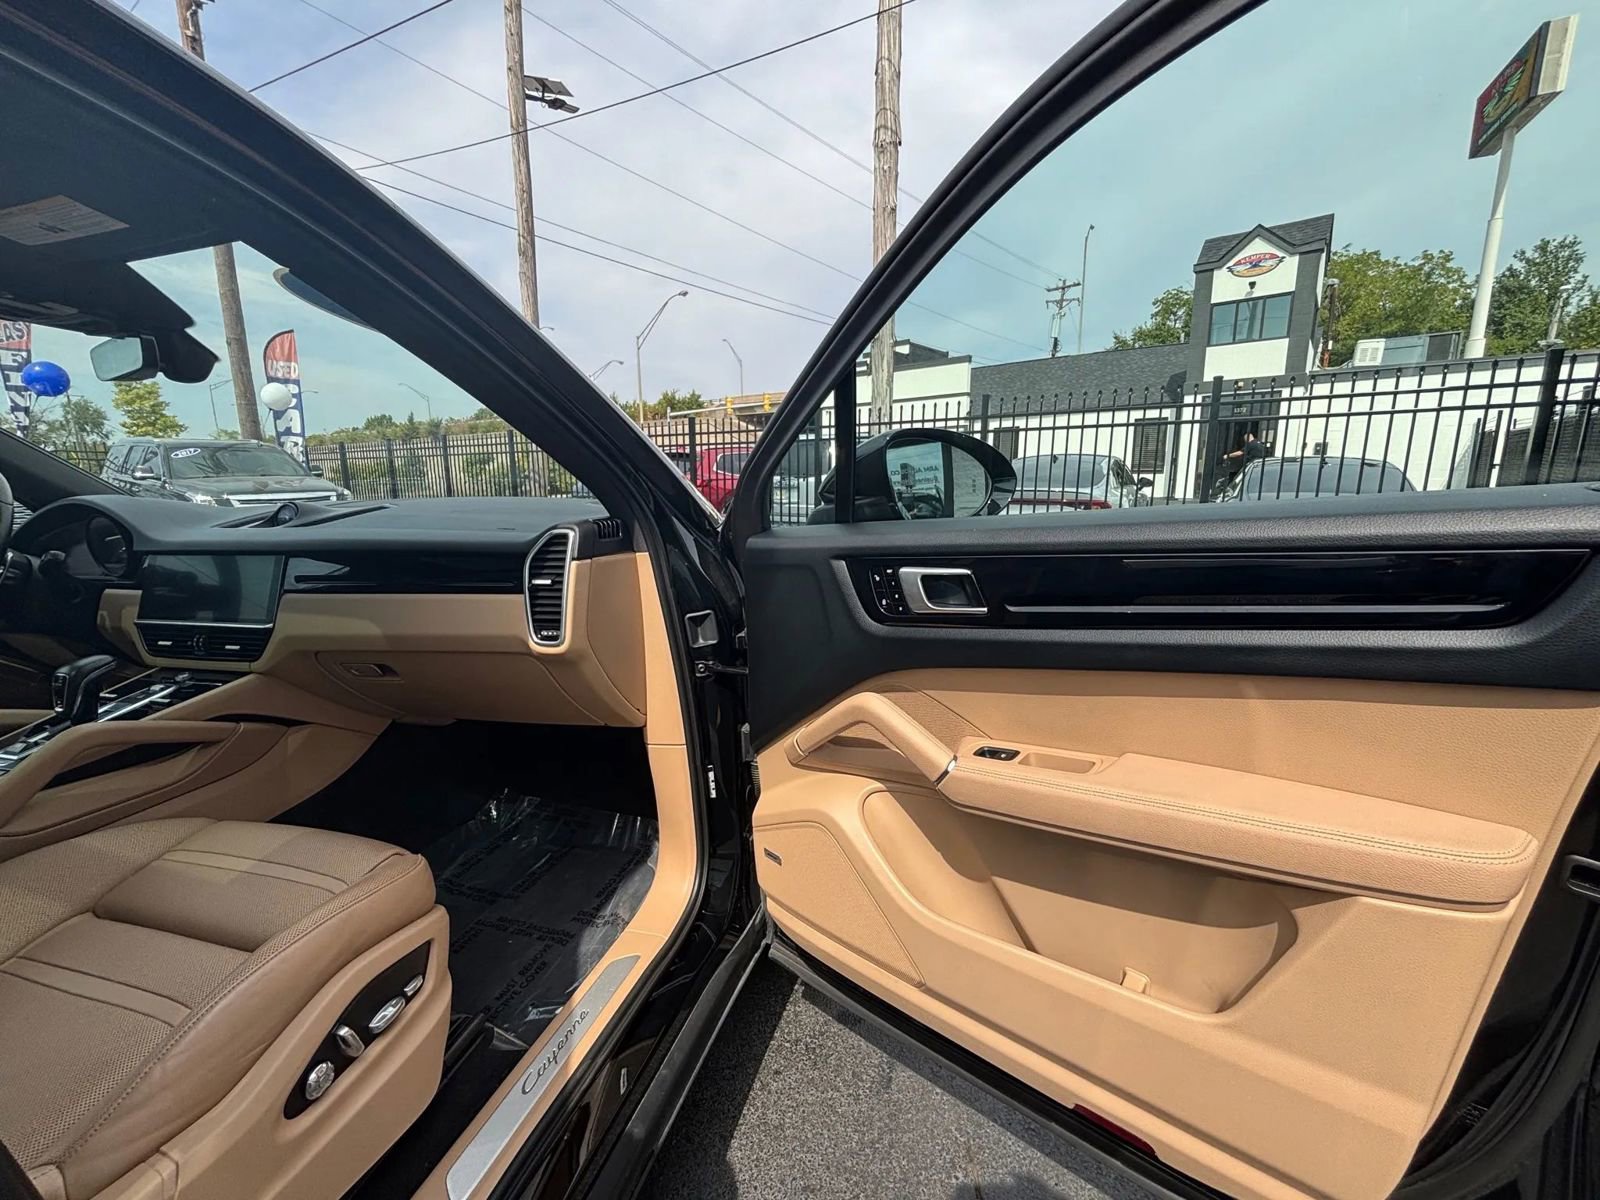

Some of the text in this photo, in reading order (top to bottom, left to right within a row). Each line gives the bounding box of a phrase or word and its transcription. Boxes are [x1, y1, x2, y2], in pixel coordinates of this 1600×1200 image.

[267, 360, 299, 379] USED
[517, 959, 548, 991] COVER
[521, 1009, 590, 1095] Cayenne
